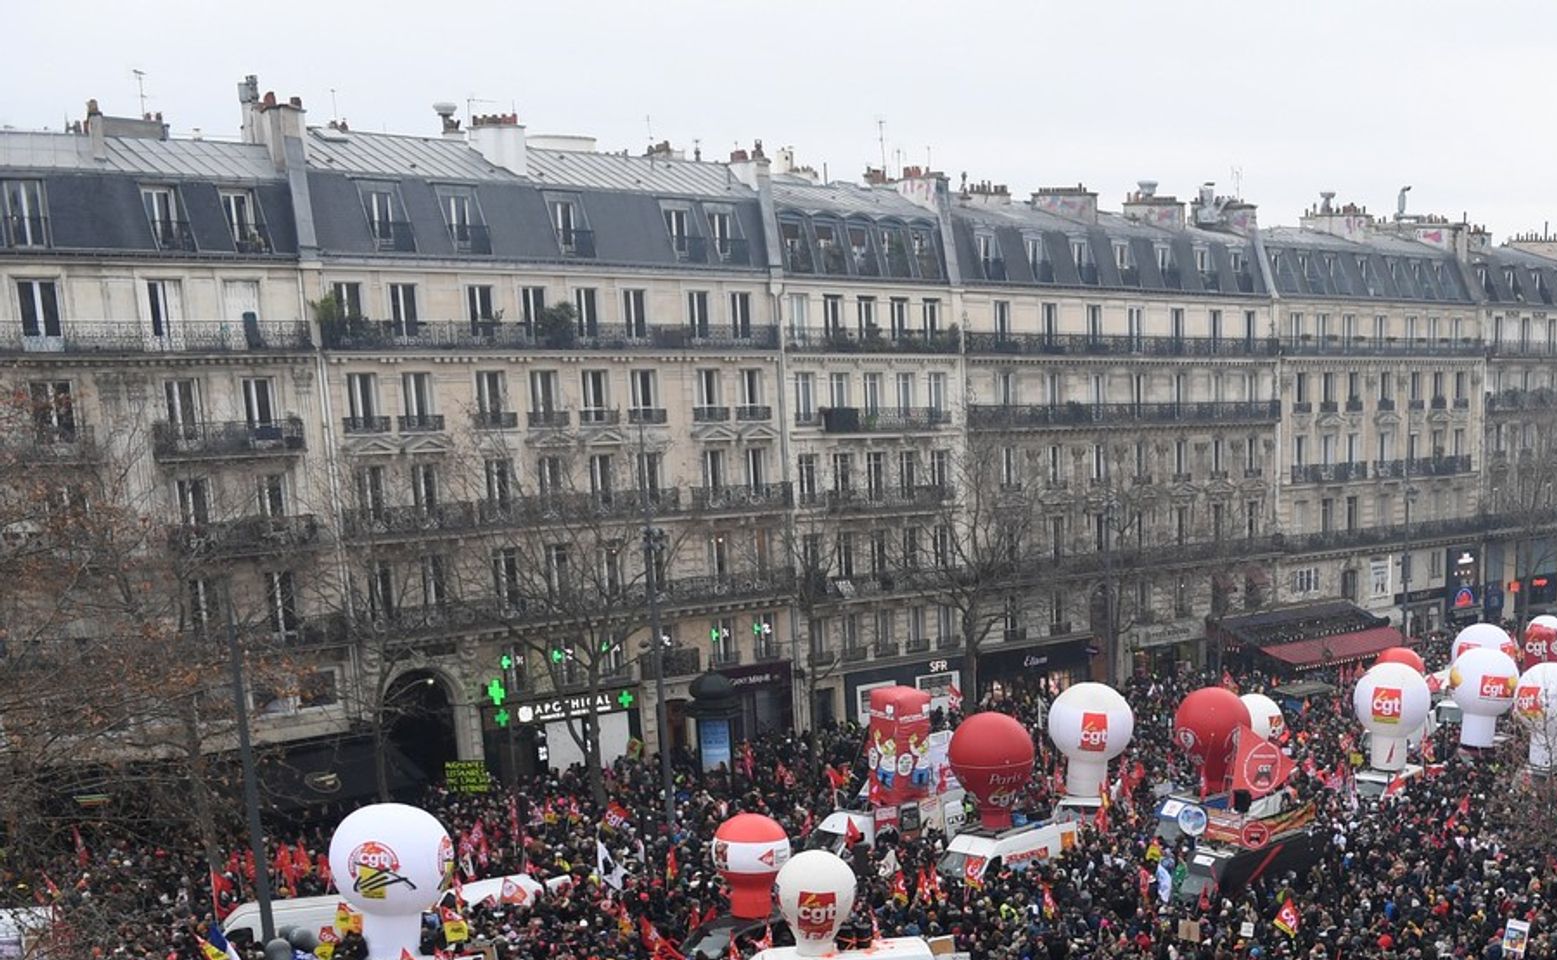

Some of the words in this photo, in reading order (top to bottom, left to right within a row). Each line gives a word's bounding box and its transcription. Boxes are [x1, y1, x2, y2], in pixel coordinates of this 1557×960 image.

[929, 660, 948, 673] SFR
[1482, 682, 1504, 696] cgt
[1373, 696, 1400, 718] cgt
[1081, 728, 1108, 745] cgt
[988, 772, 1022, 785] Paris
[799, 903, 836, 925] cgt
